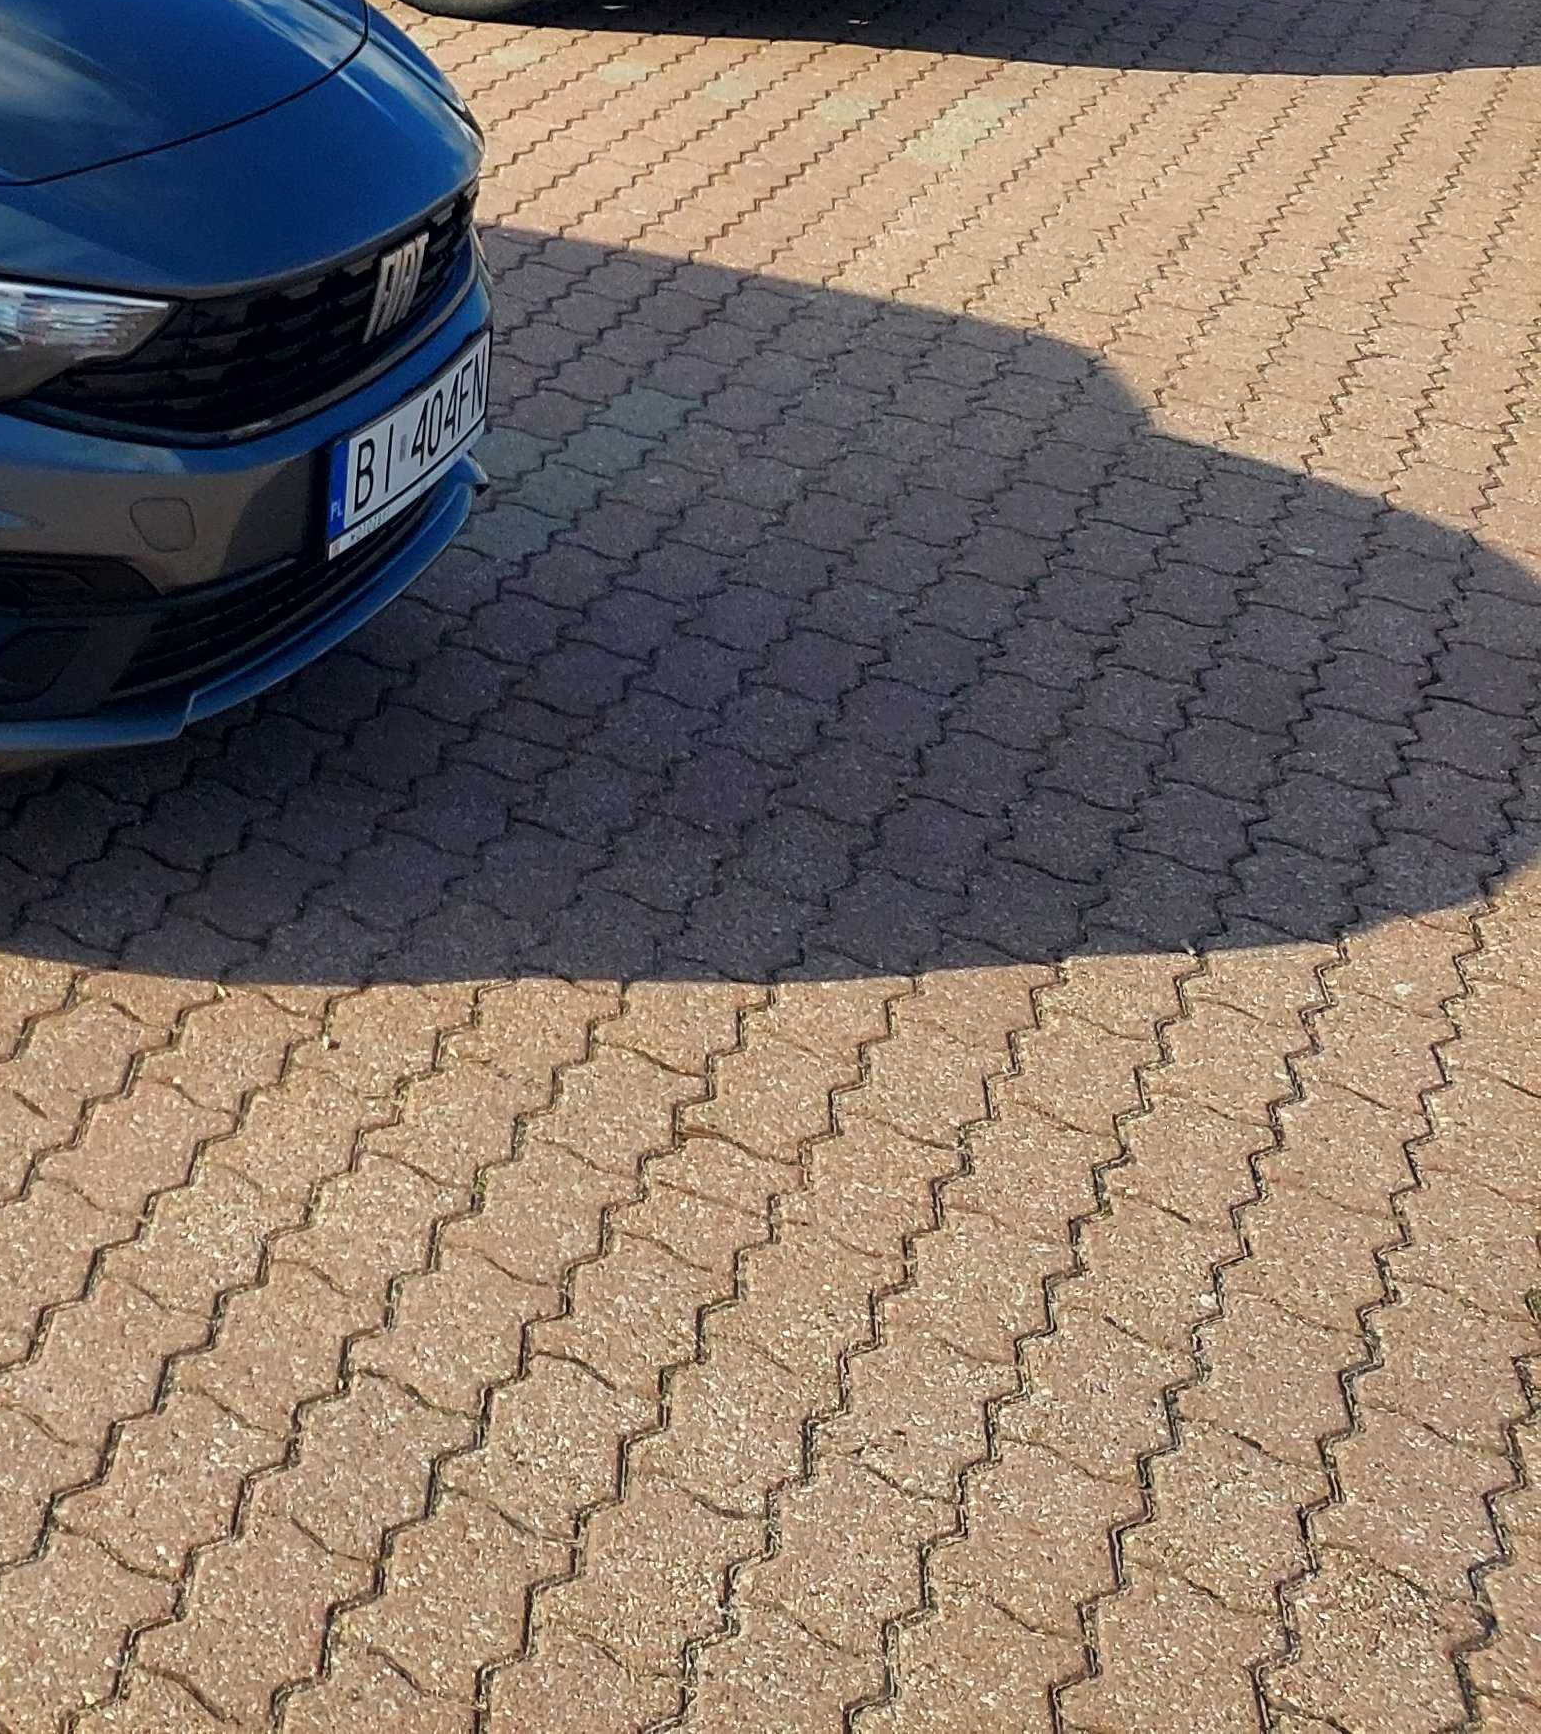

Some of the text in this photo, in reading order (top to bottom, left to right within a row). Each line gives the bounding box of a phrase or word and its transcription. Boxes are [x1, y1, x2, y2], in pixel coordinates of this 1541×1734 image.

[363, 231, 430, 344] FIAT
[354, 344, 486, 514] BI 404FN
[330, 498, 343, 522] PL
